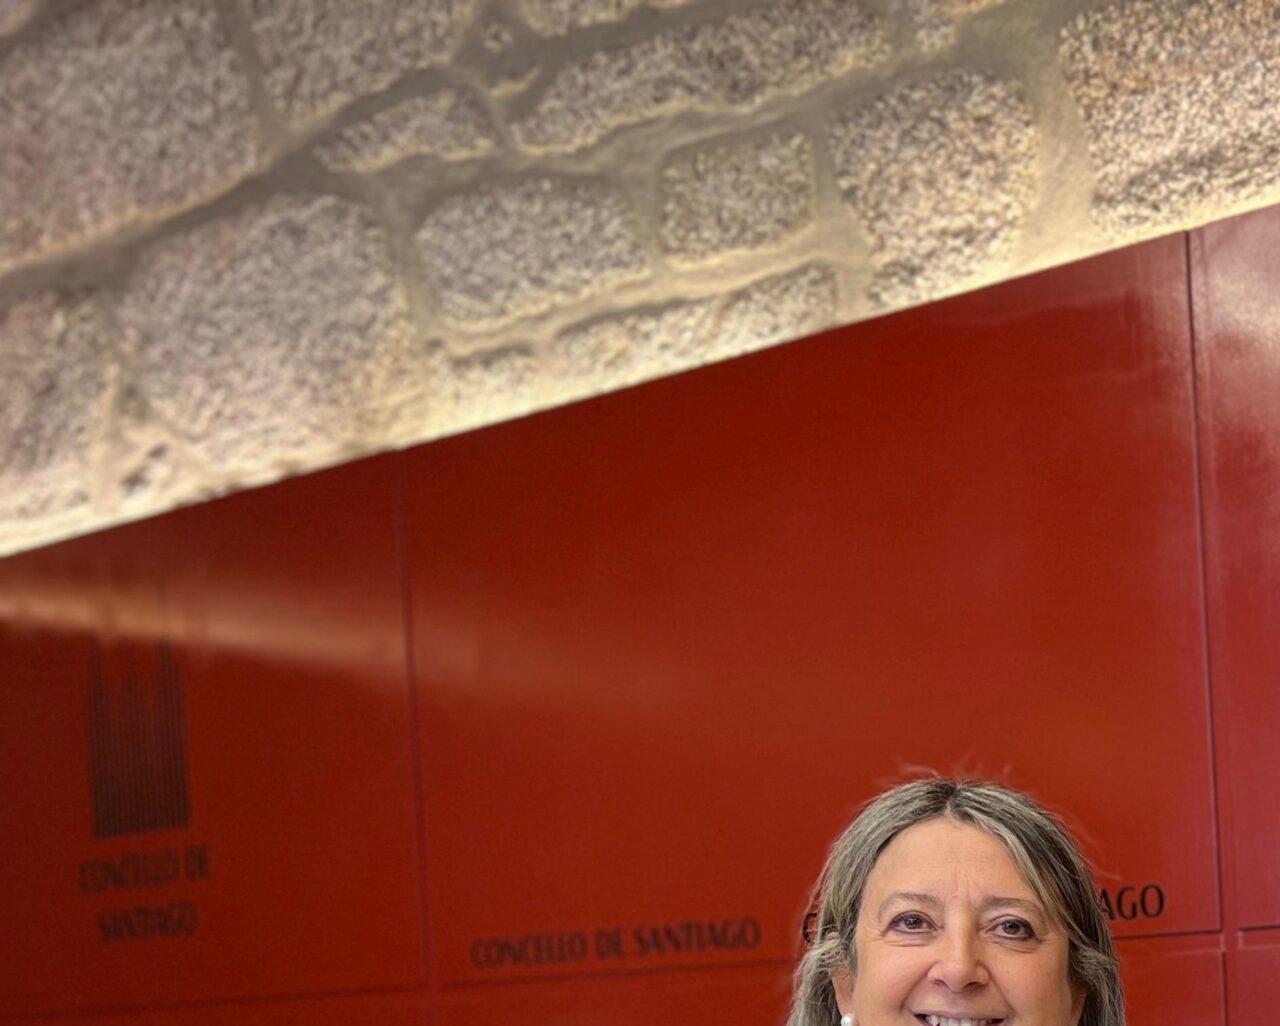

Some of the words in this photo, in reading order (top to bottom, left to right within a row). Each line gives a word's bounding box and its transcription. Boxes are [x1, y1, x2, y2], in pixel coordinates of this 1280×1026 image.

[471, 930, 587, 967] CONCELLO
[596, 928, 625, 958] DE
[633, 918, 762, 955] SANTIAGO
